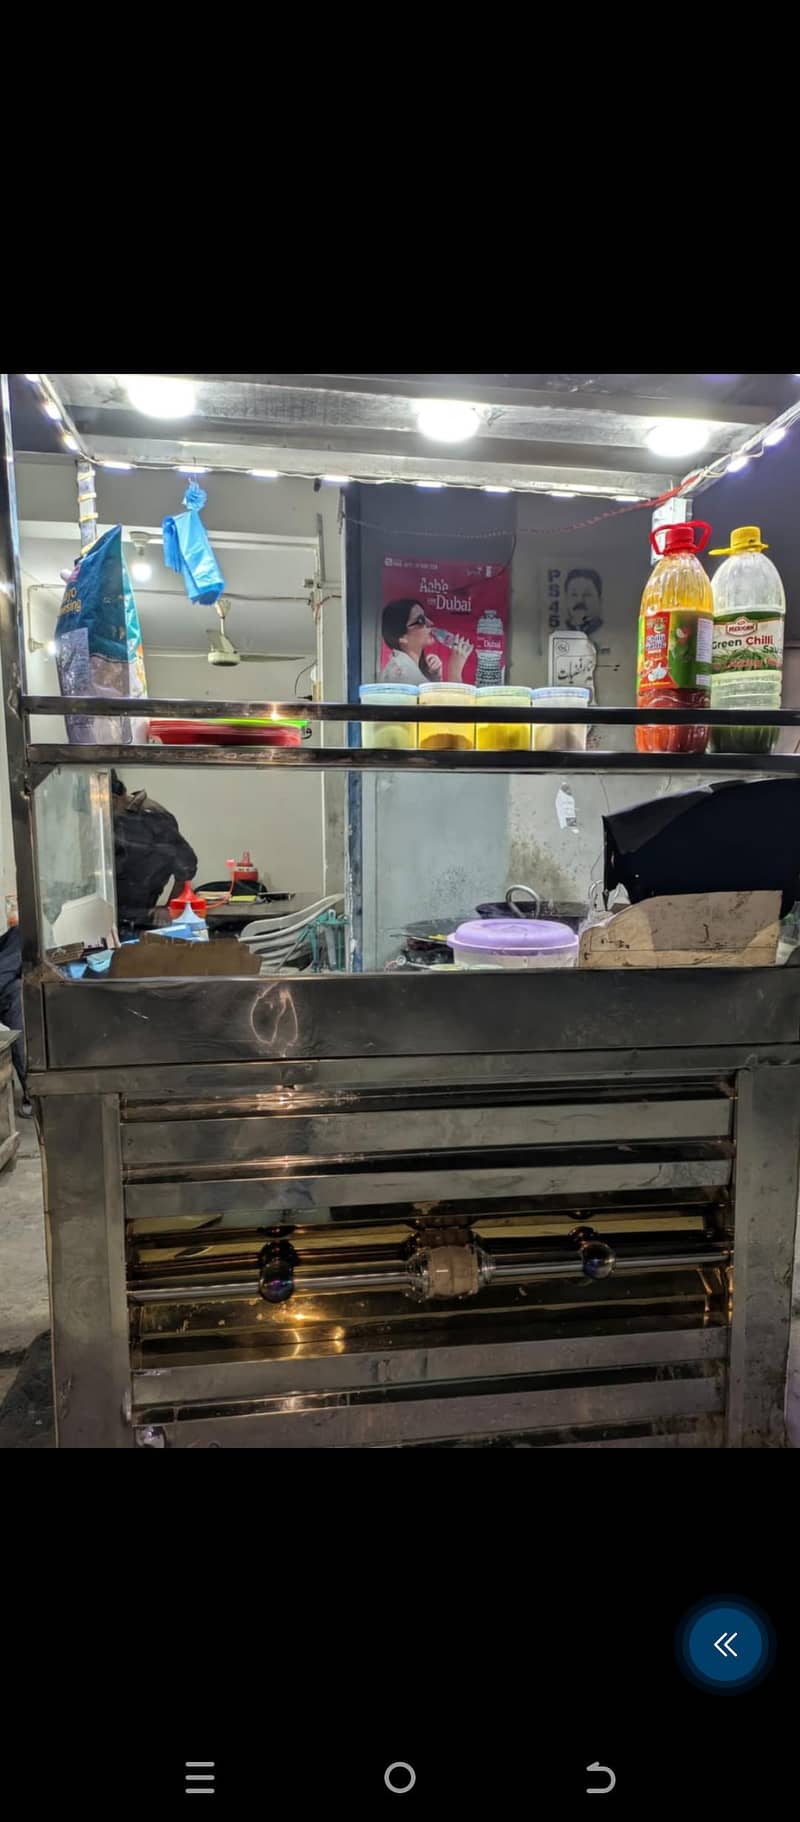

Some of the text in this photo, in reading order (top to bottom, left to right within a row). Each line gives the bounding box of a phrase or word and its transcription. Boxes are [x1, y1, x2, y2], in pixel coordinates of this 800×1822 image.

[435, 594, 472, 612] Dubai
[712, 634, 774, 650] Green Chilli
